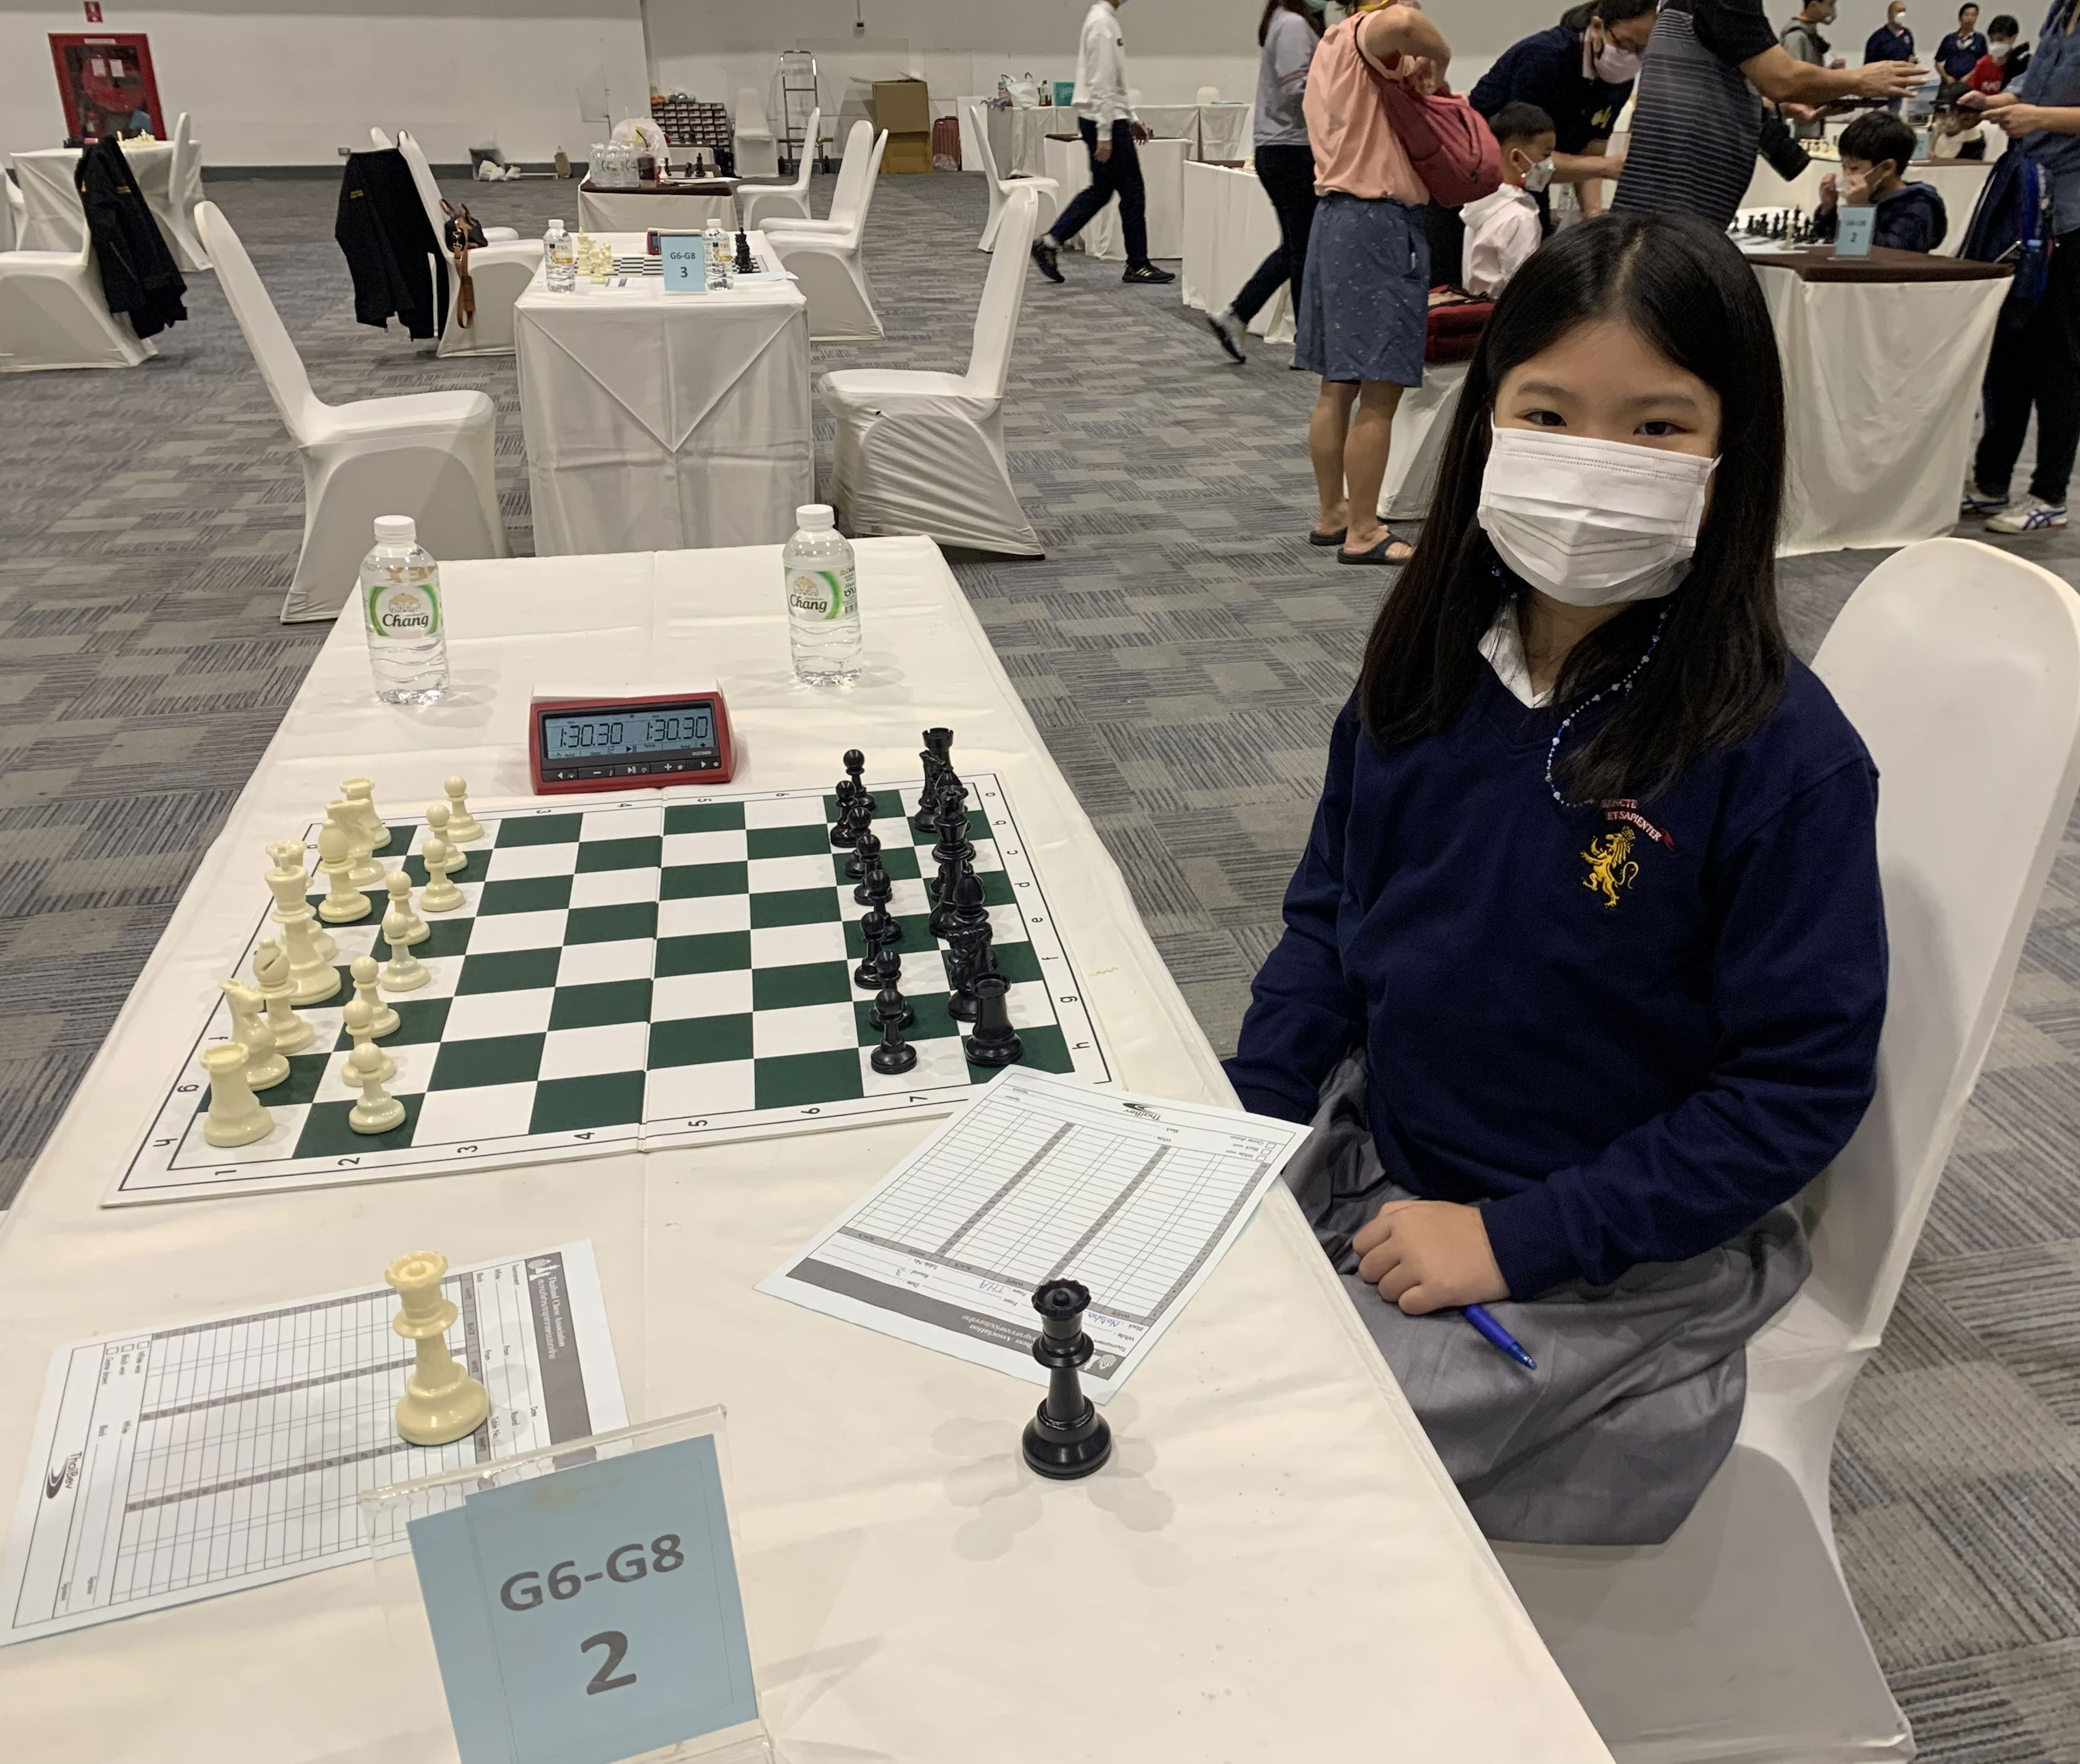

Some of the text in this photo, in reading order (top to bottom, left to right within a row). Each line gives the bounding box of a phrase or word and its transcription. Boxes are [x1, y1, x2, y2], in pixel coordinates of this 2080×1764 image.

[681, 267, 688, 278] 3
[790, 594, 828, 613] Chang
[382, 613, 429, 628] Chang
[647, 716, 708, 741] 1:30.30
[560, 722, 623, 748] 1:30.30
[1607, 811, 1661, 841] ET SAPIENTER
[1071, 1041, 1091, 1050] h
[177, 1084, 199, 1093] g
[1123, 1108, 1161, 1122] ThaiBev
[688, 1119, 708, 1128] 5
[574, 1131, 595, 1141] 4
[152, 1138, 178, 1148] h
[456, 1145, 479, 1154] 3
[337, 1157, 361, 1166] 2
[953, 1262, 973, 1271] BLACK
[911, 1270, 930, 1279] Round
[1006, 1278, 1024, 1287] WHITE
[1013, 1288, 1028, 1297] From
[1004, 1298, 1019, 1307] From
[548, 1275, 559, 1300] Thailand
[554, 1312, 565, 1347] Association
[1111, 1310, 1130, 1319] WHITE
[969, 1324, 1015, 1343] Association
[1128, 1324, 1145, 1332] Black
[1117, 1333, 1135, 1342] White
[471, 1359, 479, 1374] WHITE
[530, 1405, 538, 1418] Date
[511, 1411, 519, 1426] Round
[478, 1437, 487, 1452] WHITE
[64, 1451, 83, 1489] ThaiBev
[500, 1534, 685, 1612] G6-G8
[580, 1630, 637, 1696] 2
